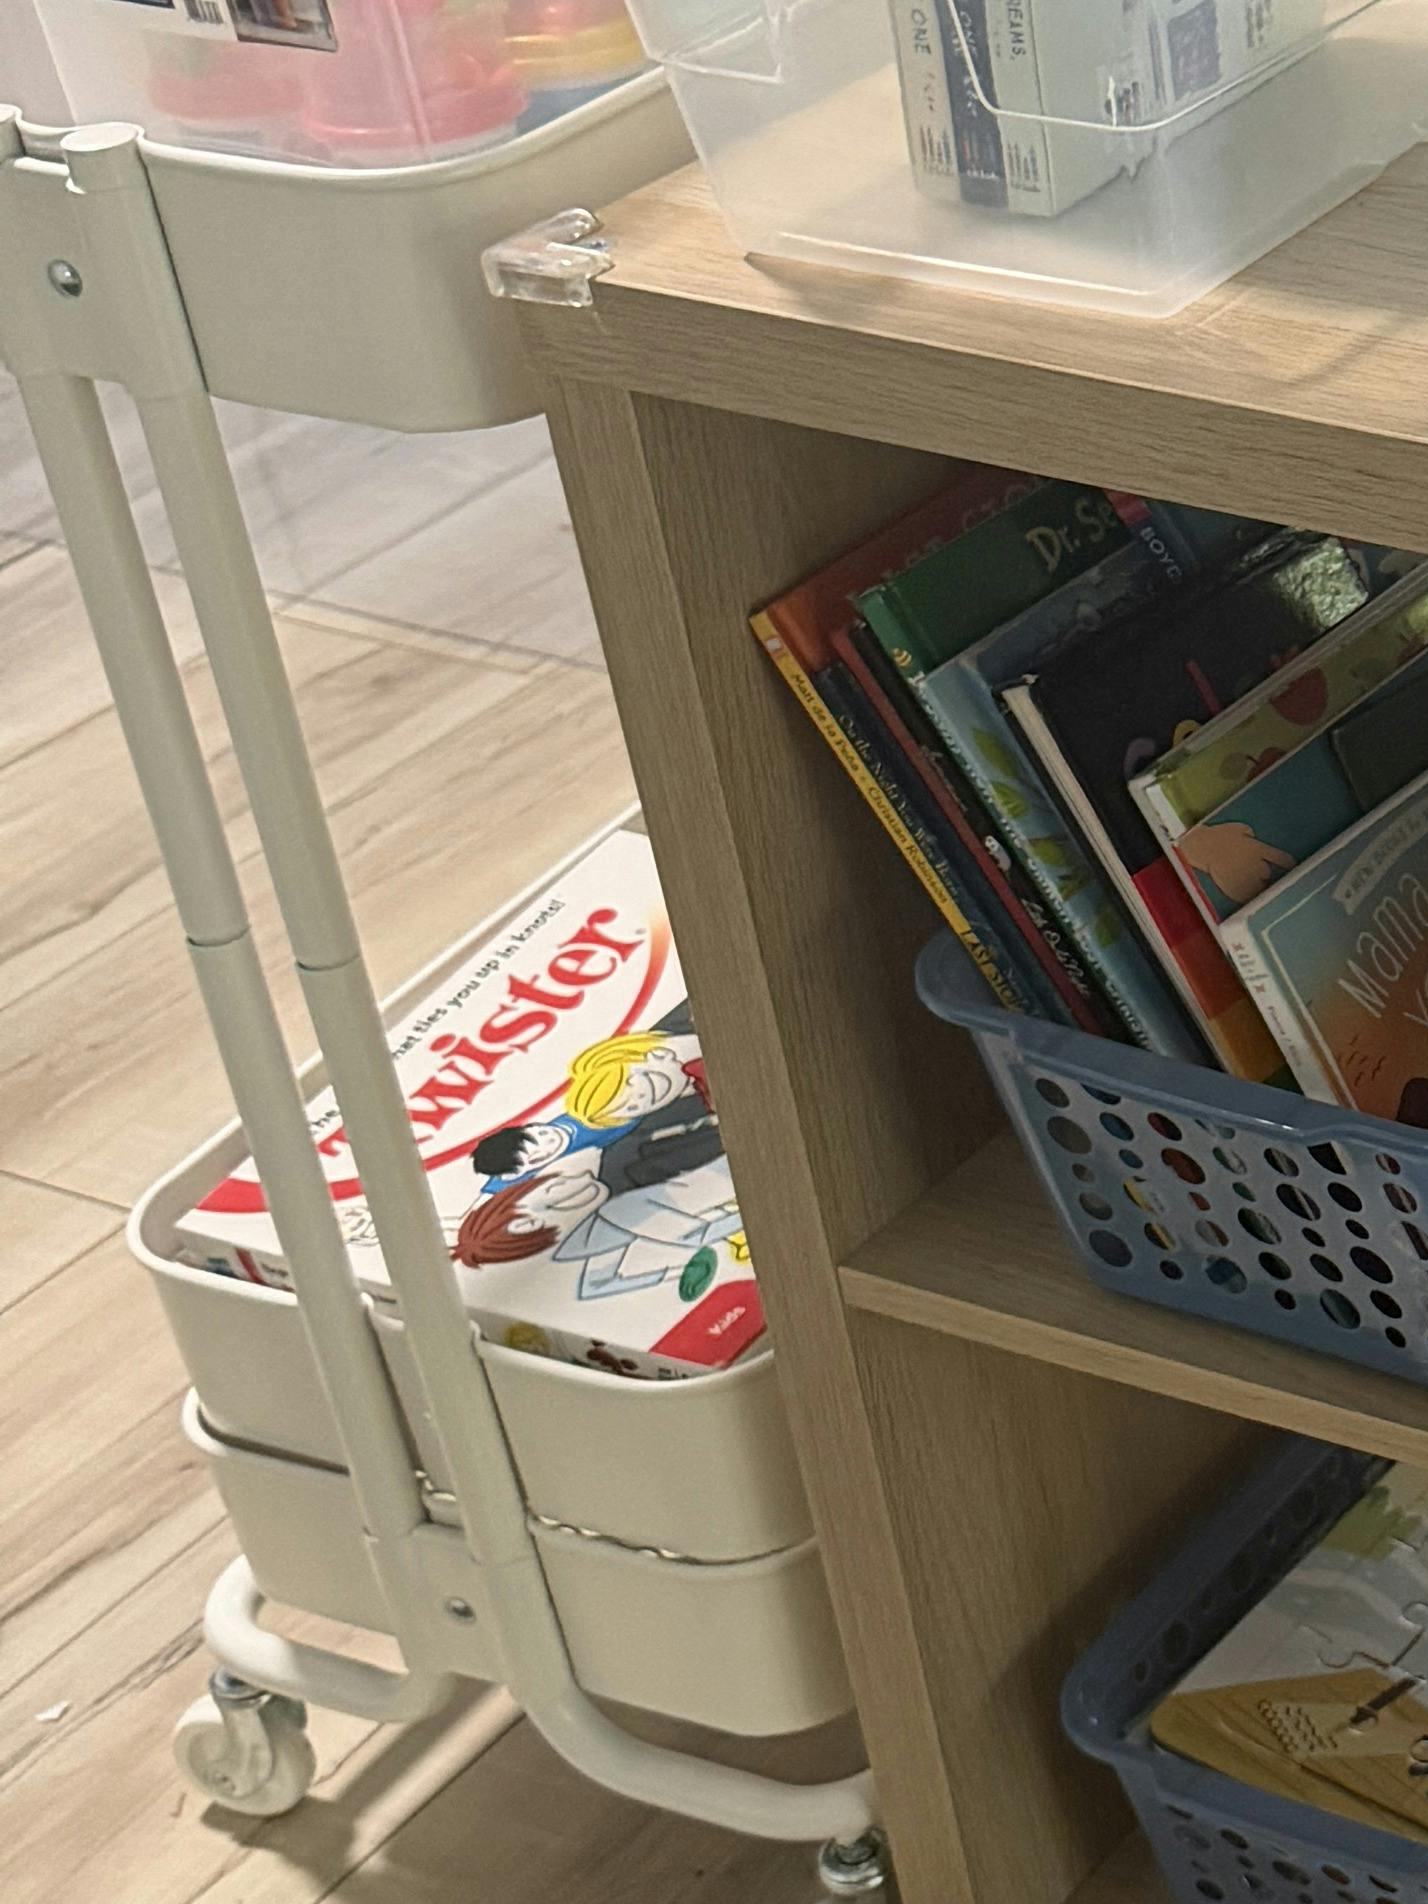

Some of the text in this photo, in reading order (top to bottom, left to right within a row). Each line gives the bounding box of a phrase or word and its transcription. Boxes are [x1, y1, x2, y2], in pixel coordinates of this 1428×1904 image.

[912, 9, 931, 55] ONE
[789, 670, 817, 704] Matt
[810, 700, 831, 724] de
[823, 720, 841, 739] la
[865, 783, 912, 846] Christian
[904, 844, 950, 905] Robinson
[956, 926, 995, 972] LAST
[853, 736, 875, 760] the
[867, 760, 902, 803] Night
[894, 799, 918, 829] You
[911, 826, 938, 860] Were
[416, 1006, 449, 1035] ties
[448, 977, 481, 1010] you
[475, 959, 502, 987] up
[495, 943, 520, 962] in
[510, 898, 566, 944] knots!
